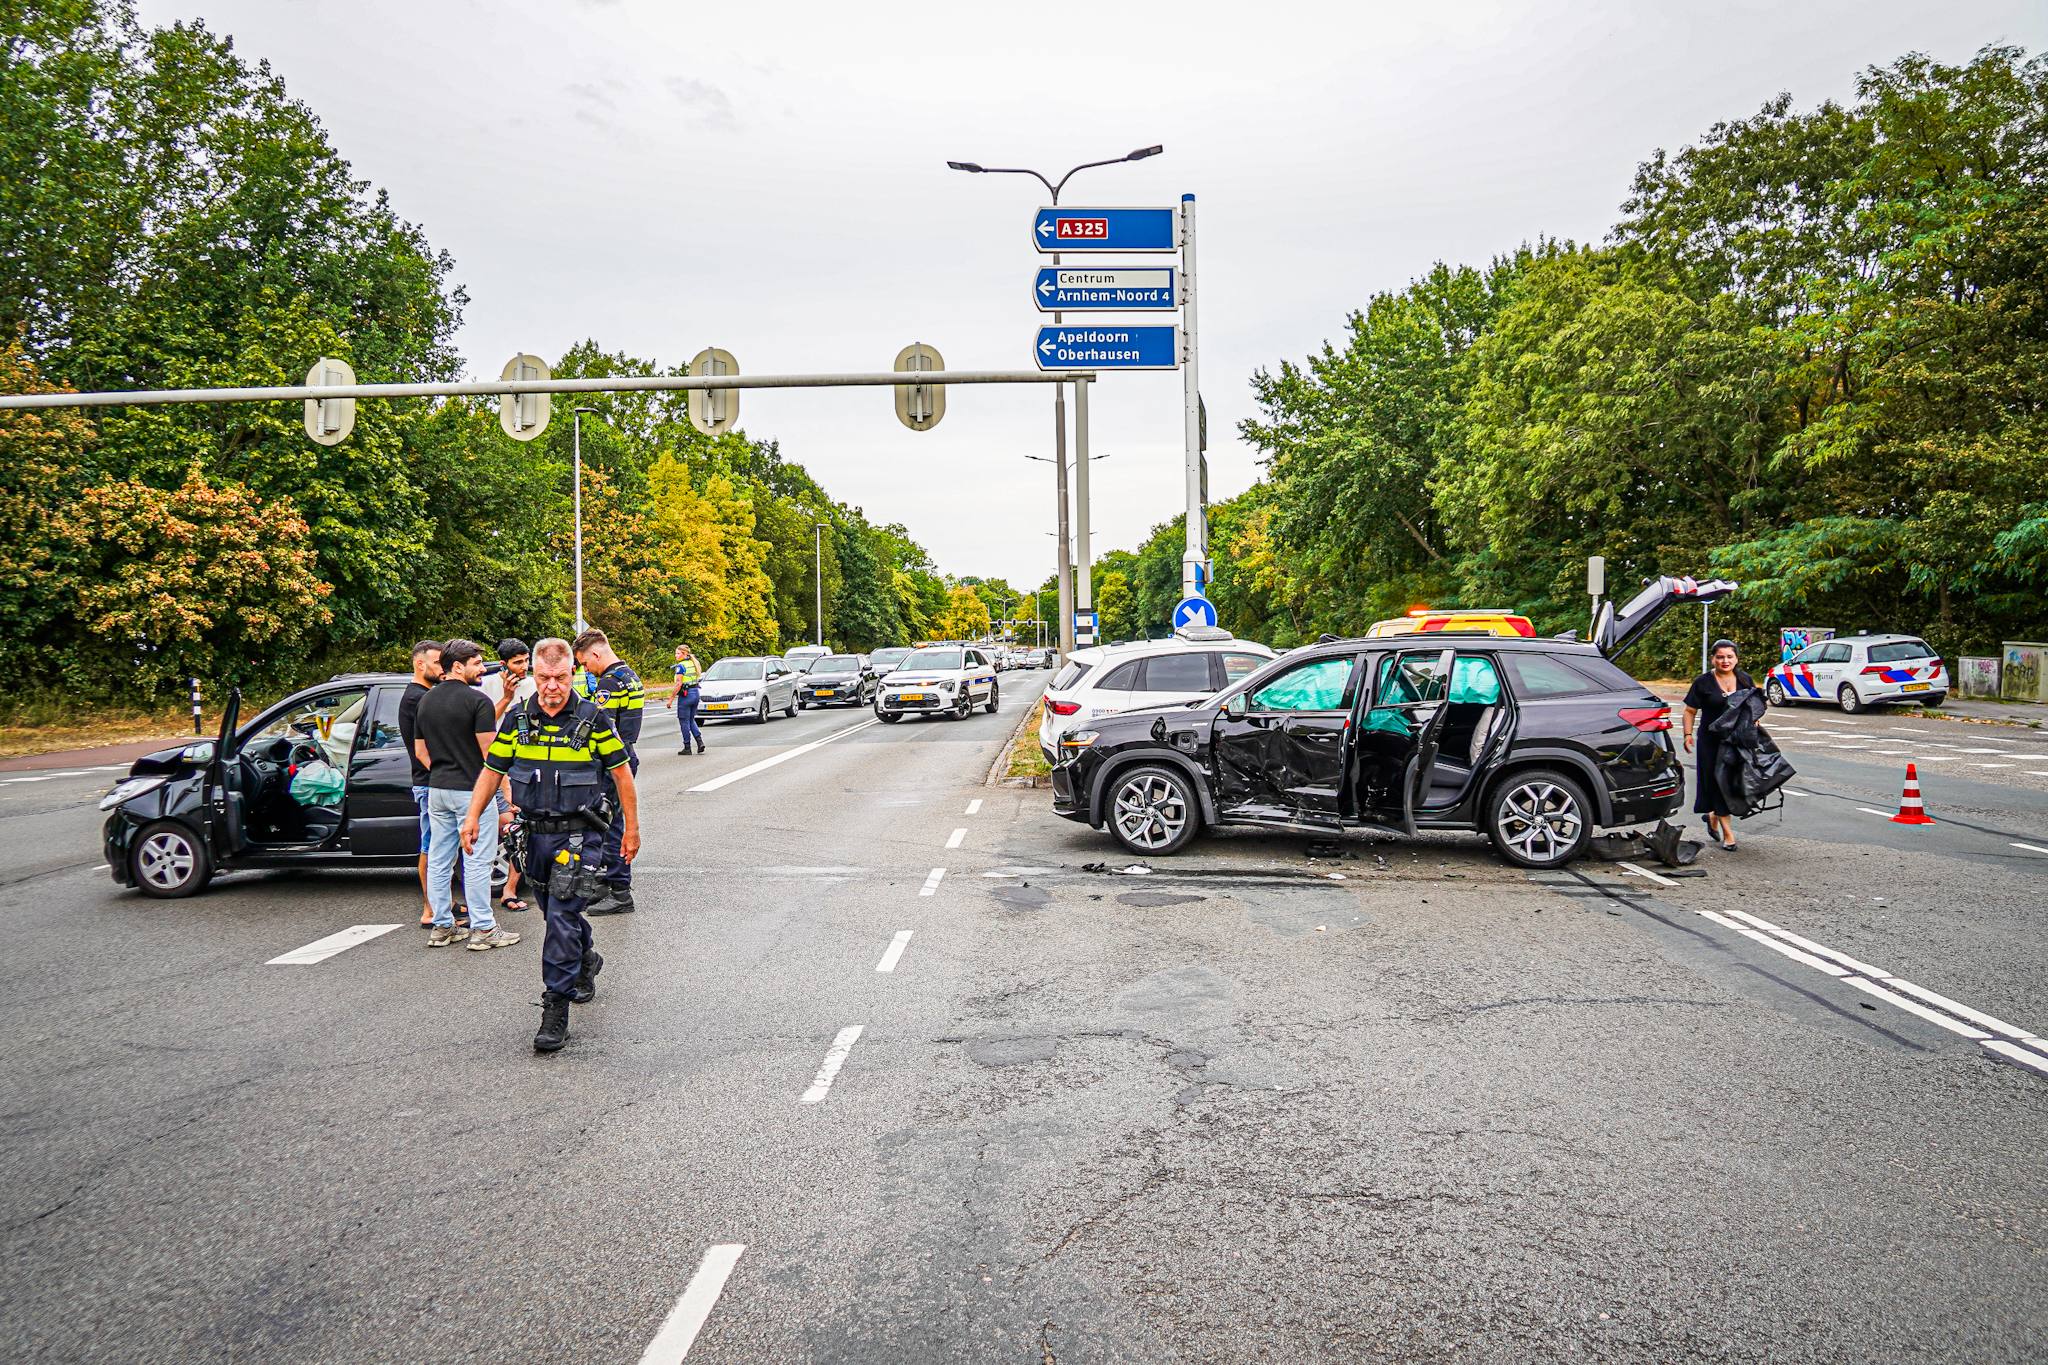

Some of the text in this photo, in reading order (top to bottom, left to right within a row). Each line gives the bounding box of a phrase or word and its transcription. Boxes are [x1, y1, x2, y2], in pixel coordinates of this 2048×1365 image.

[1061, 222, 1104, 235] A325
[1060, 273, 1115, 284] Centrum
[1057, 290, 1169, 301] Arnhem-Noord 4
[1058, 331, 1129, 345] Apeldoorn
[1058, 348, 1140, 360] Oberhausen
